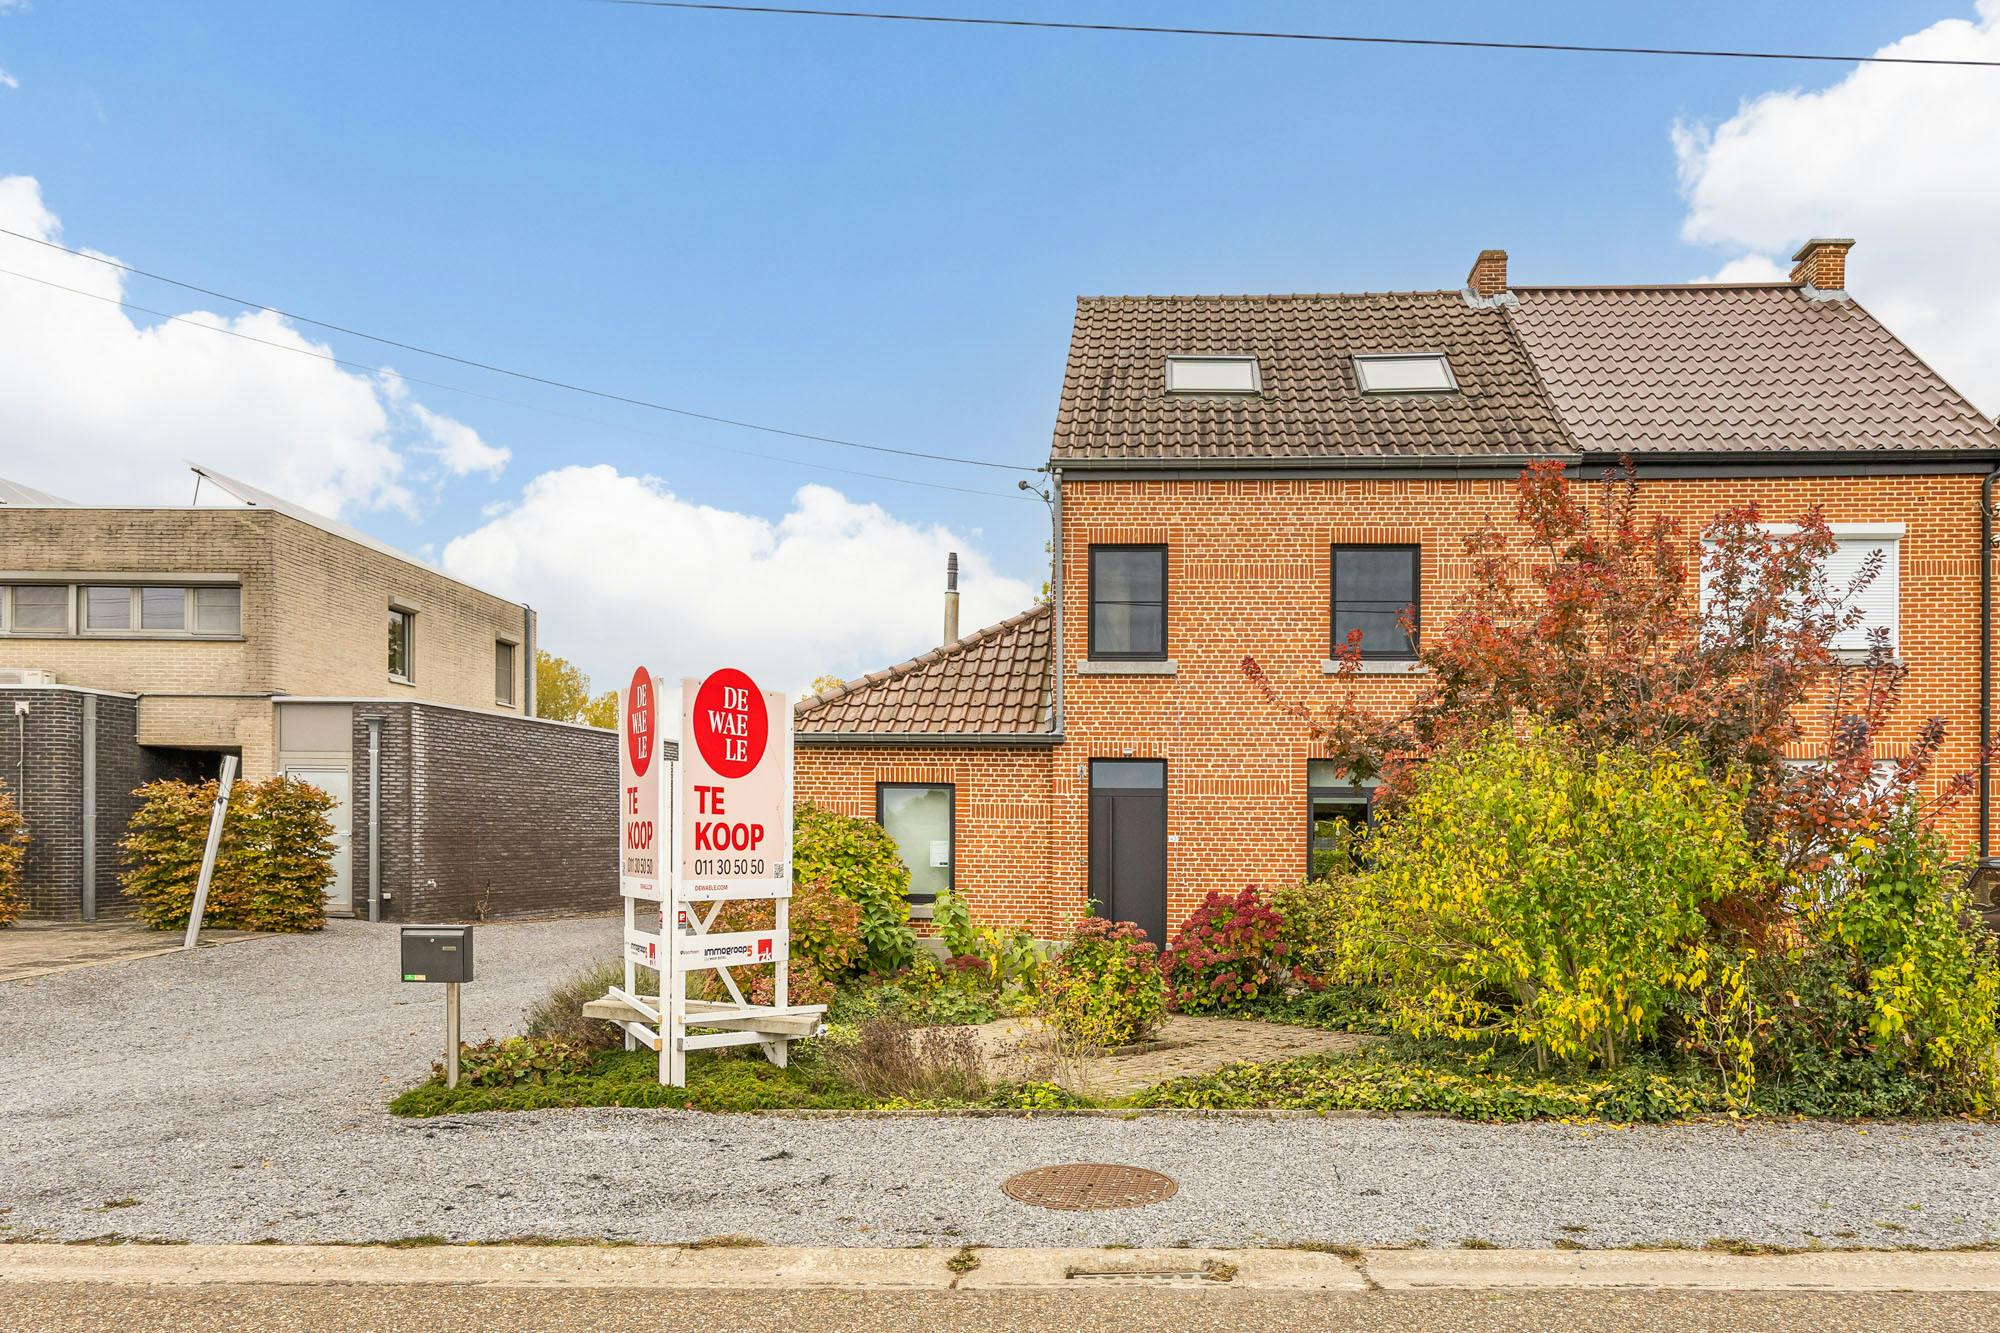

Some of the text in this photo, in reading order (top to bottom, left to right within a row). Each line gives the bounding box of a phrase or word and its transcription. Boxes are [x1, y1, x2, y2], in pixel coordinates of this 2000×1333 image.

[637, 684, 647, 708] DE
[724, 686, 748, 711] DE
[632, 710, 647, 735] WAE
[707, 710, 748, 737] WAE
[638, 736, 647, 759] LE
[725, 738, 747, 762] LE
[627, 787, 638, 815] TE
[694, 785, 725, 815] TE
[627, 821, 653, 849] KOOP
[695, 822, 764, 851] KOOP
[695, 859, 764, 875] 011 30 50 50
[694, 884, 728, 892] DEWAELE.COM
